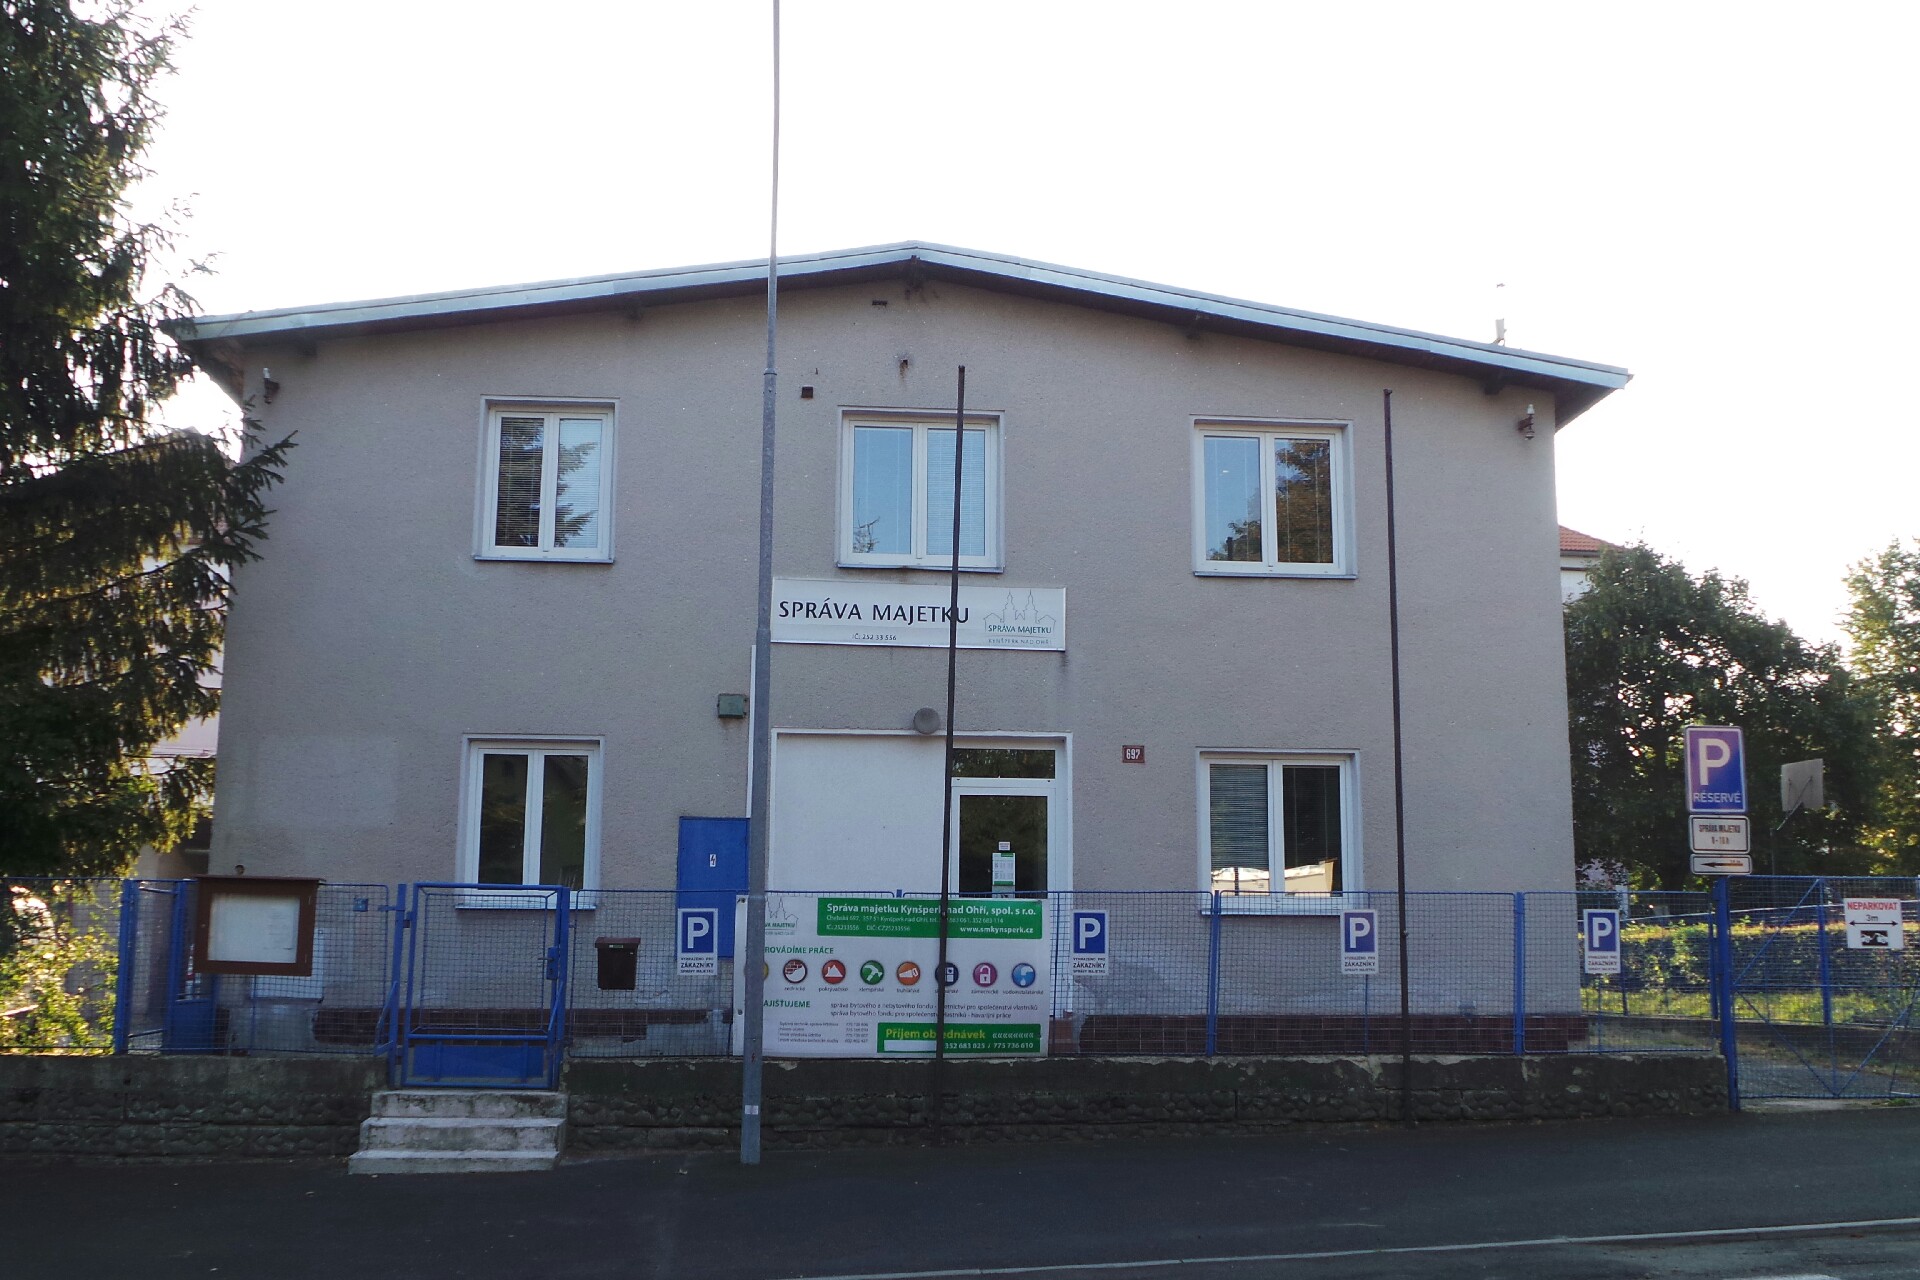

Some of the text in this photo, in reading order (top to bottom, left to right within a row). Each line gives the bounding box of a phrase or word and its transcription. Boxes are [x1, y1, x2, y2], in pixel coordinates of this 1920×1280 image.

[778, 597, 969, 625] SPRÁVA MAJETKU
[988, 624, 1052, 634] SPRÁVA MAJETKU
[1126, 748, 1140, 760] 697
[1698, 738, 1730, 786] P
[1693, 791, 1741, 803] RÉSERVÉ
[827, 903, 858, 913] Správa
[860, 904, 899, 914] majetku
[991, 906, 1013, 916] spol.
[1847, 902, 1898, 910] NEPARKOVAT
[687, 916, 710, 948] P
[960, 926, 1033, 934] www.smkynsperk.cz
[1080, 918, 1101, 949] P
[1350, 918, 1370, 948] P
[1593, 917, 1612, 948] P
[765, 945, 834, 954] ROVÁDÍME PRÁCE
[763, 999, 810, 1008] AJIŠŤUJEME
[886, 1028, 921, 1040] Příjem
